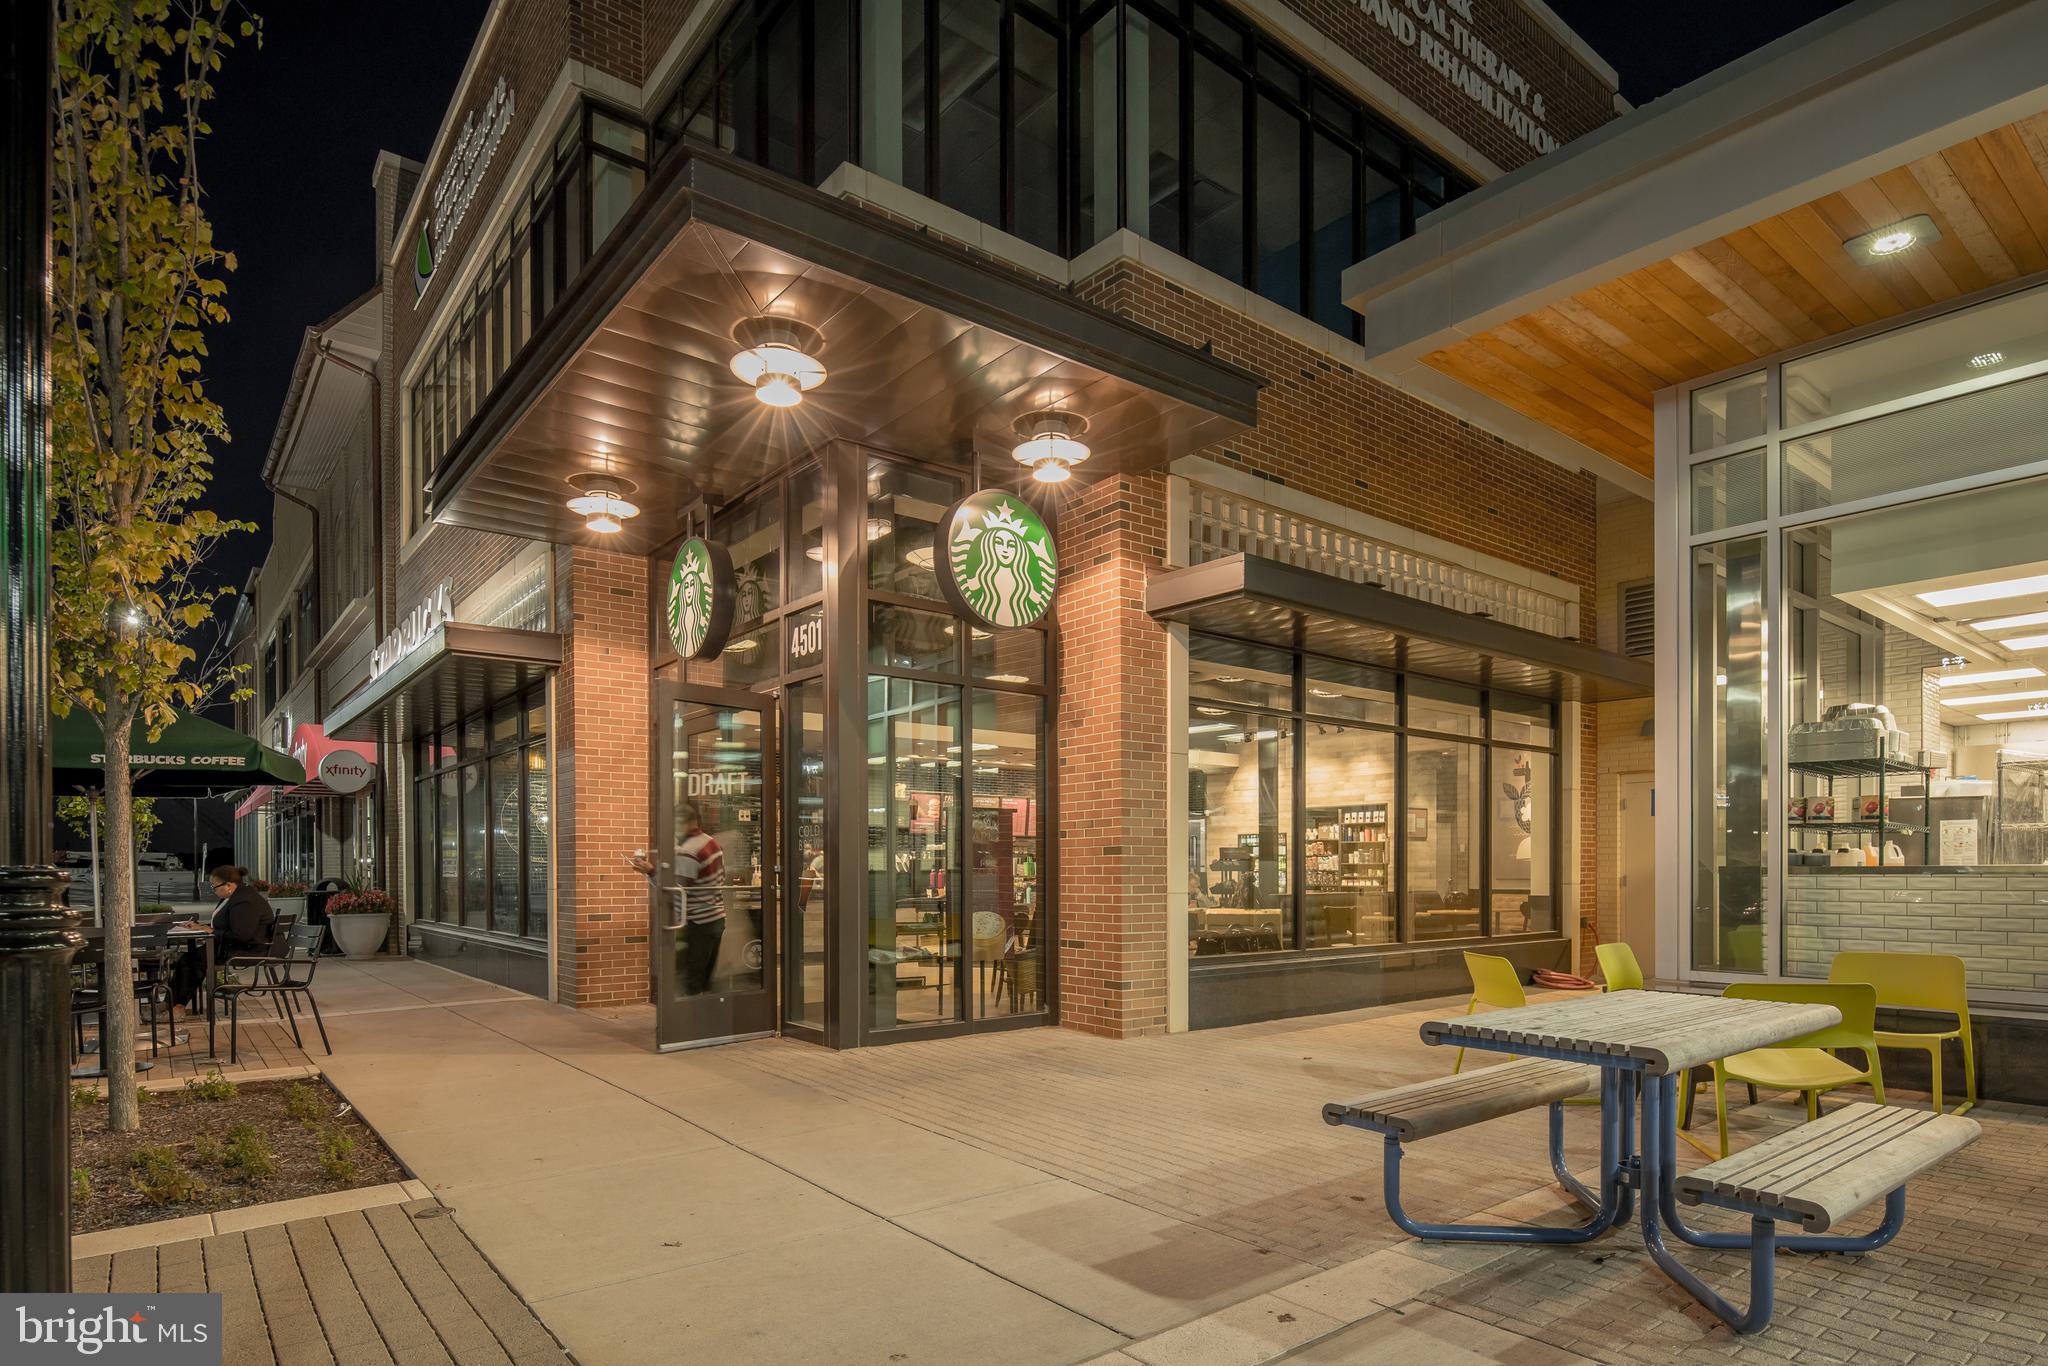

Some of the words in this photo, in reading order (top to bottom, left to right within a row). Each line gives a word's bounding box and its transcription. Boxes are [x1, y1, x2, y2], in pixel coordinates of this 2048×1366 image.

[1449, 18, 1531, 106] THERAPY
[1532, 92, 1546, 122] &
[791, 618, 822, 658] 4501
[90, 753, 186, 766] STRBUCKS
[190, 756, 246, 766] COFFEE
[325, 764, 367, 778] xfinity
[687, 771, 749, 797] DRAFT
[798, 824, 820, 838] COLD
